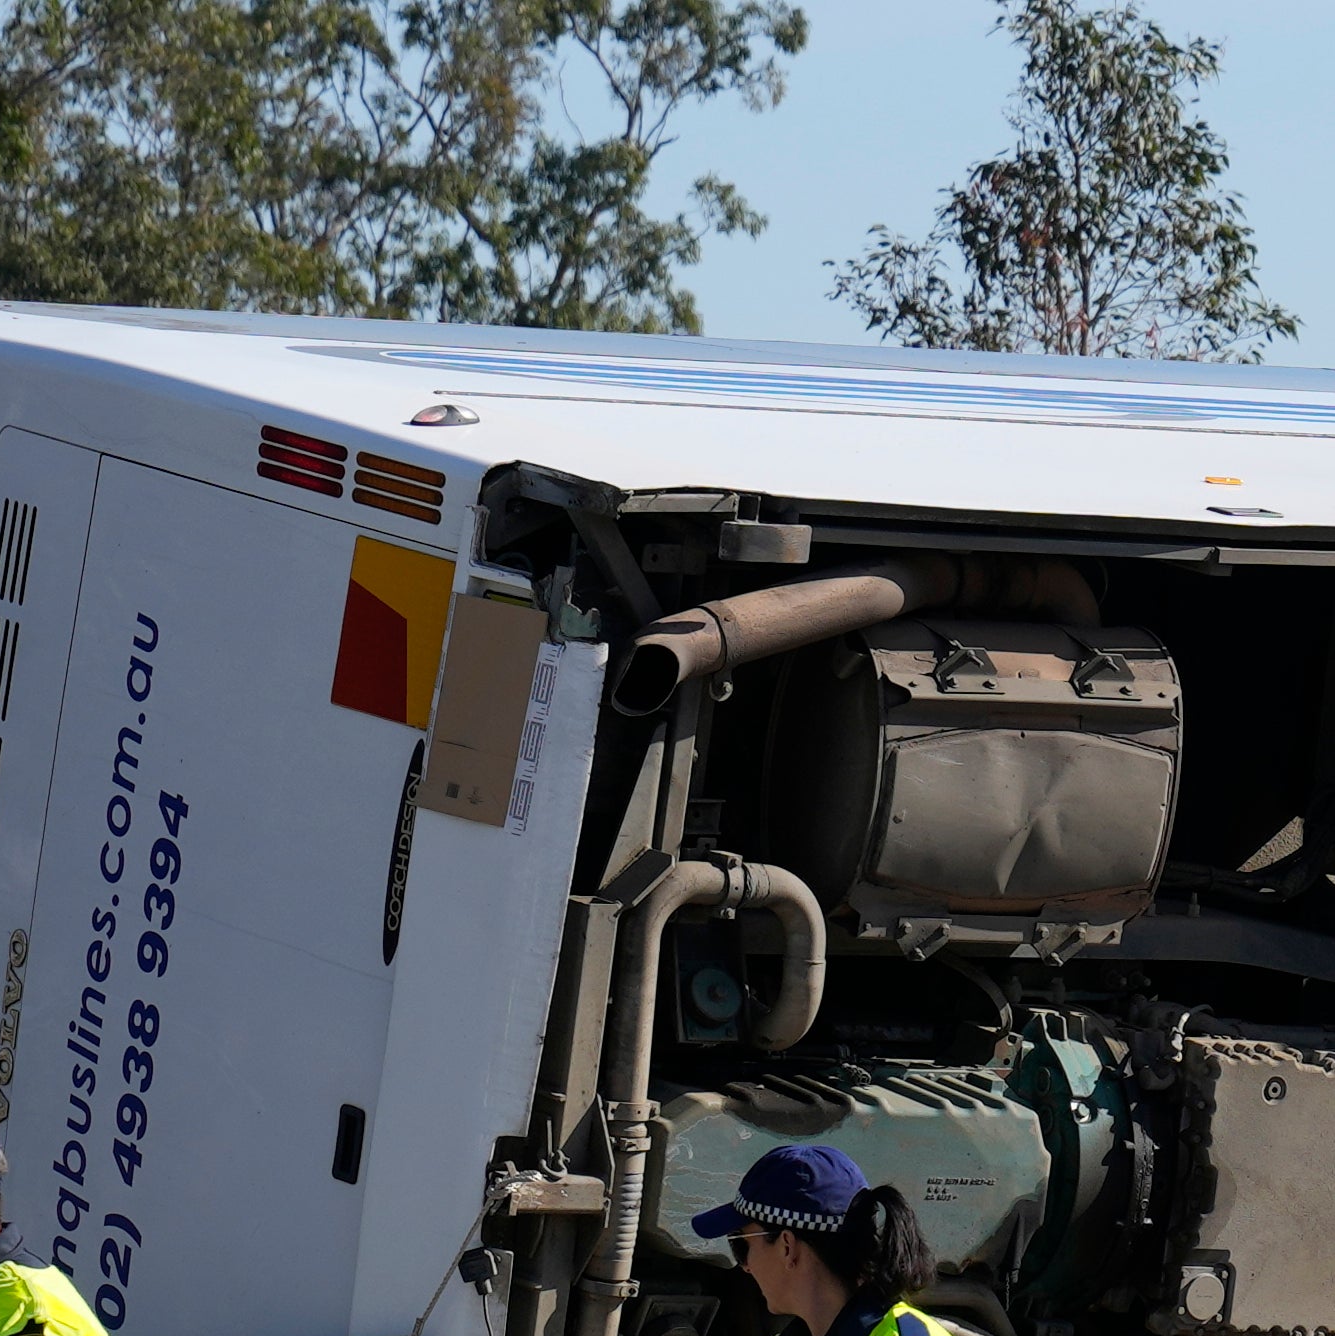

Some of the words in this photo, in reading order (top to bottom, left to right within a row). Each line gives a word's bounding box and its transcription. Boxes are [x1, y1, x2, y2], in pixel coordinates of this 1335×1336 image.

[52, 613, 159, 1275] nqbuslines.com.au
[136, 791, 190, 978] 9394
[387, 853, 409, 930] COACH
[399, 772, 421, 852] DESIGN
[113, 999, 162, 1188] 4938
